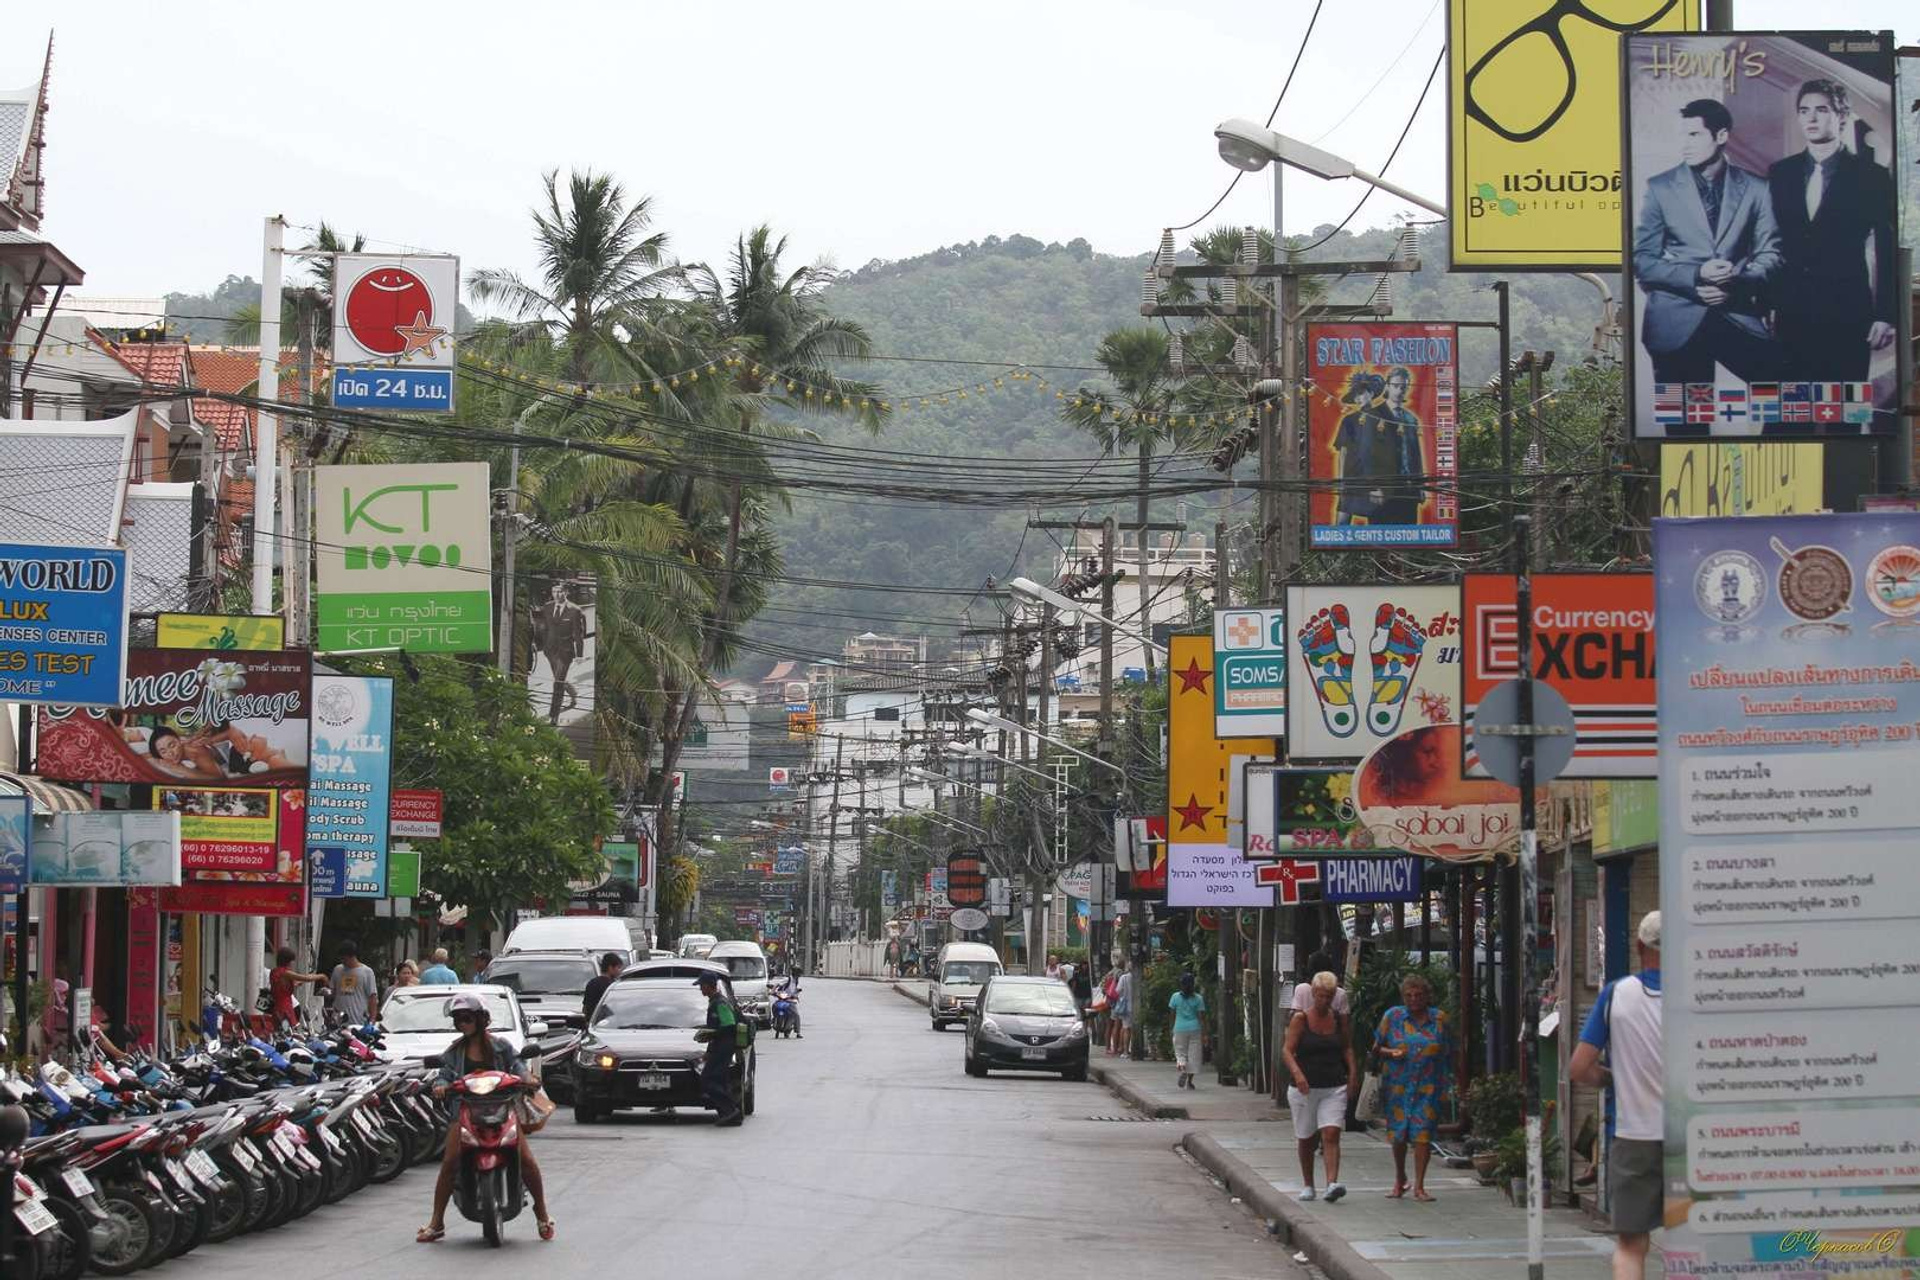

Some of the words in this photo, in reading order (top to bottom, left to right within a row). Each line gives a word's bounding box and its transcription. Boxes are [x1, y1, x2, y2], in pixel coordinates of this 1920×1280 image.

[1640, 40, 1766, 94] Henry's
[1470, 196, 1584, 218] Beutiful
[1316, 337, 1365, 367] STAR
[1370, 336, 1452, 367] FASHION
[338, 379, 369, 397] เปิด
[375, 379, 407, 397] 24
[343, 484, 458, 535] KT
[1314, 530, 1344, 541] LADIES
[1354, 530, 1383, 541] GENTS
[1384, 530, 1419, 541] CUSTOM
[1421, 529, 1451, 541] TAILOR
[0, 558, 116, 593] WORLD
[347, 604, 379, 618] แว่น
[390, 600, 462, 622] กรุงไทย
[1534, 606, 1656, 632] Currency
[48, 629, 107, 645] CENTER
[347, 629, 378, 645] KT
[389, 627, 462, 645] OPTIC
[34, 653, 95, 676] TEST
[176, 686, 300, 727] Massage
[314, 753, 356, 774] SPA
[324, 781, 371, 792] Massage
[320, 796, 368, 811] Massage
[333, 814, 365, 825] Scrub
[390, 809, 437, 820] EXCHANGE
[1828, 809, 1846, 819] 200
[1394, 811, 1464, 836] sabai
[331, 831, 375, 844] therapy
[1291, 828, 1344, 850] SPA
[1192, 856, 1225, 864] מסעדה
[1171, 868, 1197, 878] הגדול
[1201, 869, 1239, 878] הישראלי
[1327, 858, 1413, 894] PHARMACY
[1206, 885, 1234, 894] בפוקט
[1830, 898, 1848, 908] 200
[1833, 1077, 1851, 1087] 200
